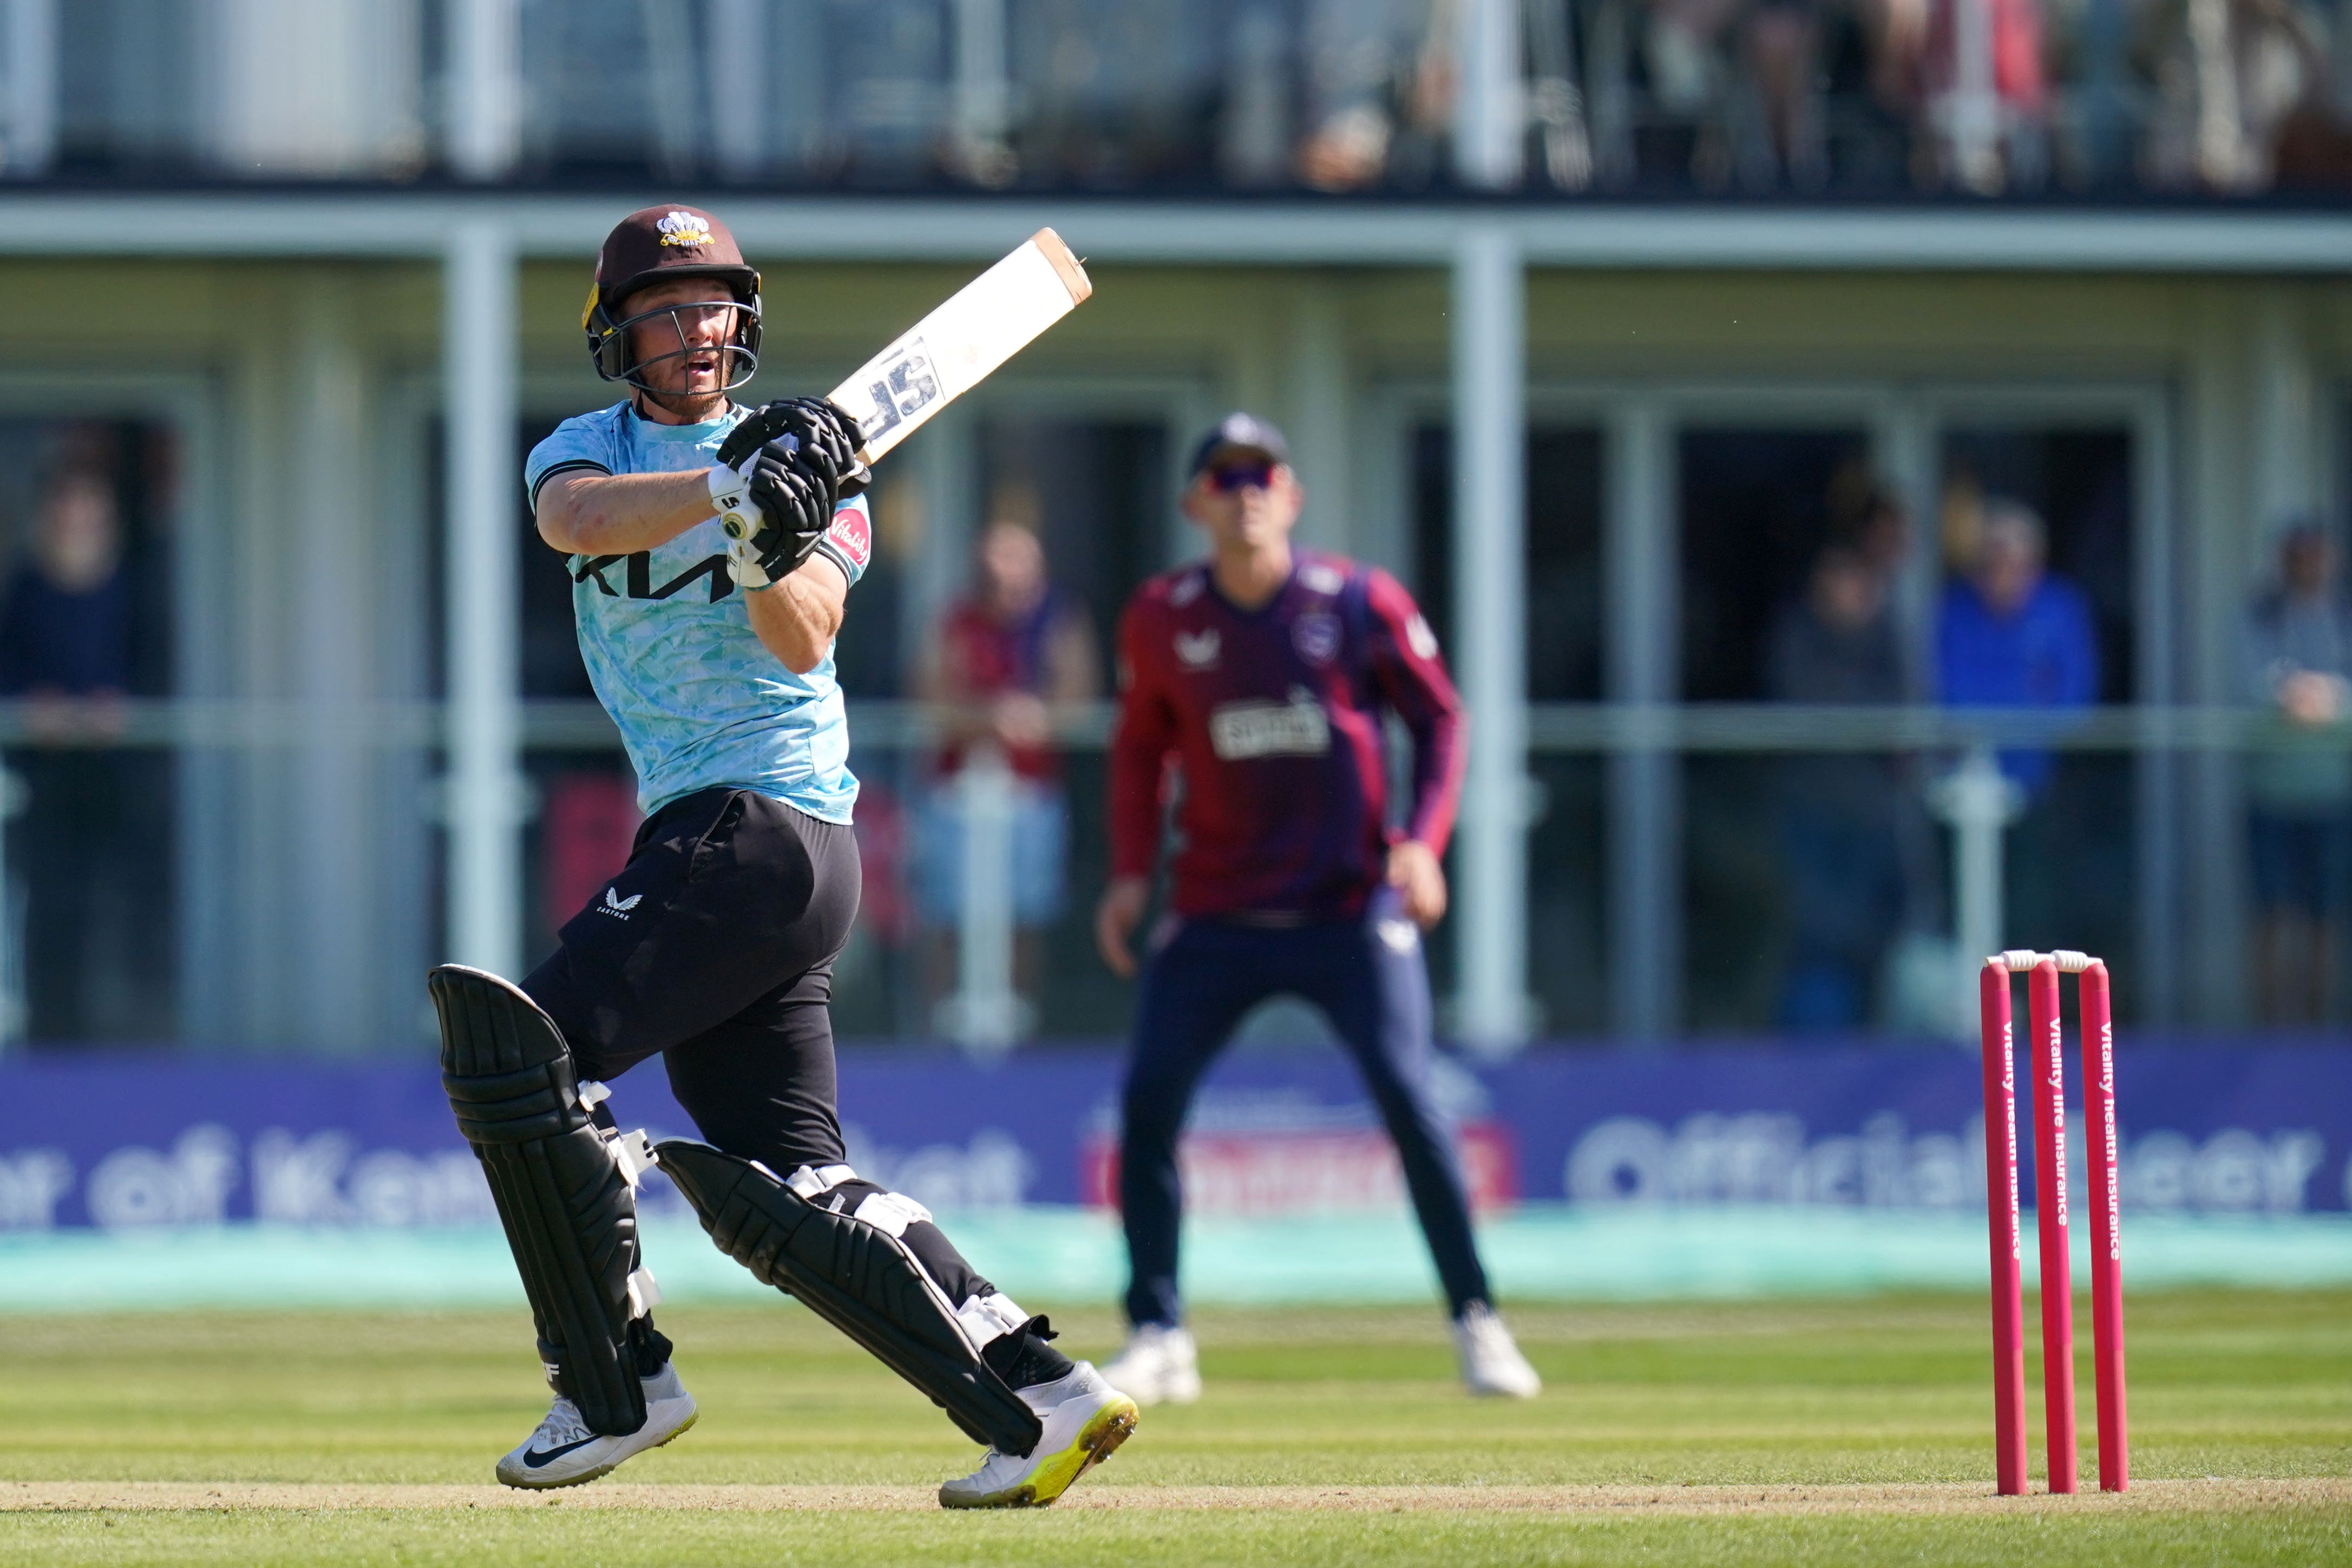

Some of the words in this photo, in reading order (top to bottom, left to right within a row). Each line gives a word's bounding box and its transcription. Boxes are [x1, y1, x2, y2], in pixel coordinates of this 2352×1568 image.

[831, 516, 868, 562] Vitality
[597, 906, 630, 921] CASTORE
[2048, 1016, 2062, 1090] Vitality
[2099, 1020, 2113, 1094] Vitality
[2002, 1020, 2014, 1093] Vitality
[2010, 1166, 2021, 1261] insurance
[2053, 1094, 2065, 1128] life
[2104, 1098, 2118, 1162] health
[2055, 1132, 2068, 1226] insurance
[2107, 1167, 2120, 1261] insurance
